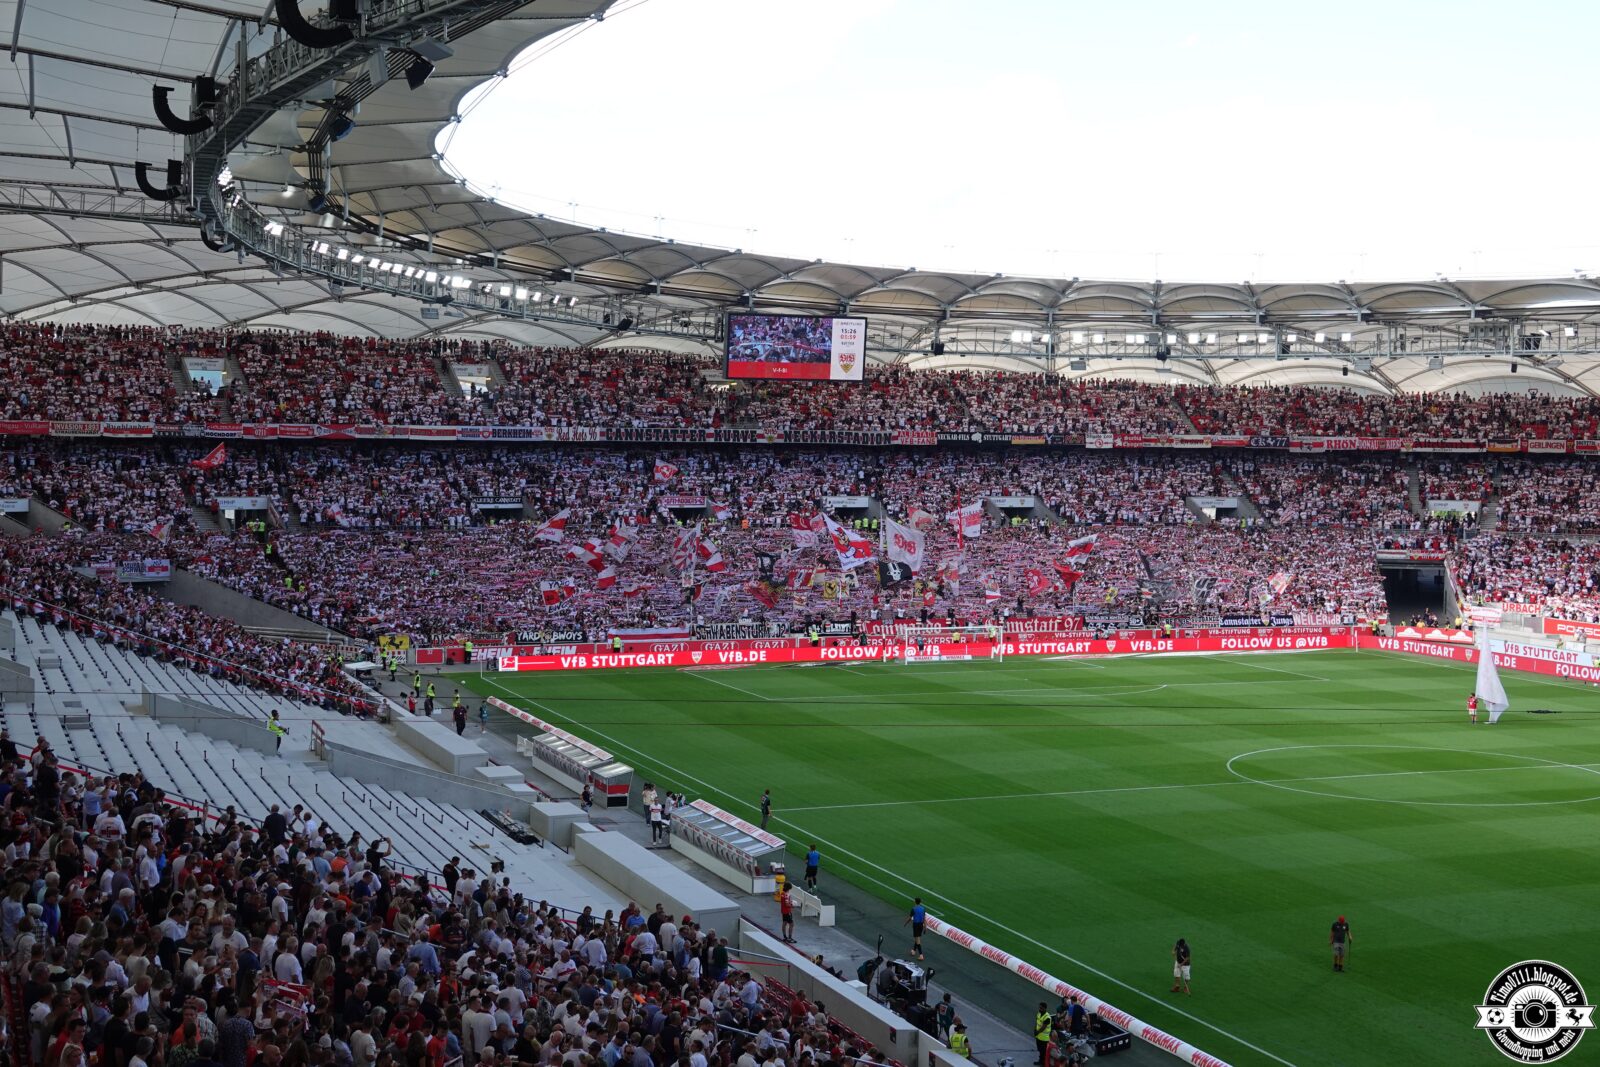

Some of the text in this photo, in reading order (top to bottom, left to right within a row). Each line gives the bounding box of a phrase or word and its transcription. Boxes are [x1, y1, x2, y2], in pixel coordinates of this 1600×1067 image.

[491, 428, 533, 439] BERKHEIM
[605, 429, 893, 445] CANNSTATTER KURVE NECKARSTADION
[897, 430, 937, 438] ALBSTADT
[983, 434, 1012, 442] STUTTGART
[1502, 602, 1541, 614] URBACH
[1064, 616, 1081, 632] 97
[516, 630, 584, 641] YARD BWOYS
[1221, 635, 1328, 649] FOLLOW US @VfB
[821, 647, 879, 659] FOLLOW
[884, 646, 900, 659] US
[1019, 641, 1092, 654] STUTTGART
[1130, 639, 1174, 651] VfB.DE
[1378, 638, 1400, 651] VfB
[1403, 641, 1455, 659] STUTTGART
[1504, 642, 1579, 664] VfB STUTTGART
[560, 650, 767, 669] VfB STUTTGART VfB.DE
[1141, 1026, 1184, 1056] WINAMAX
